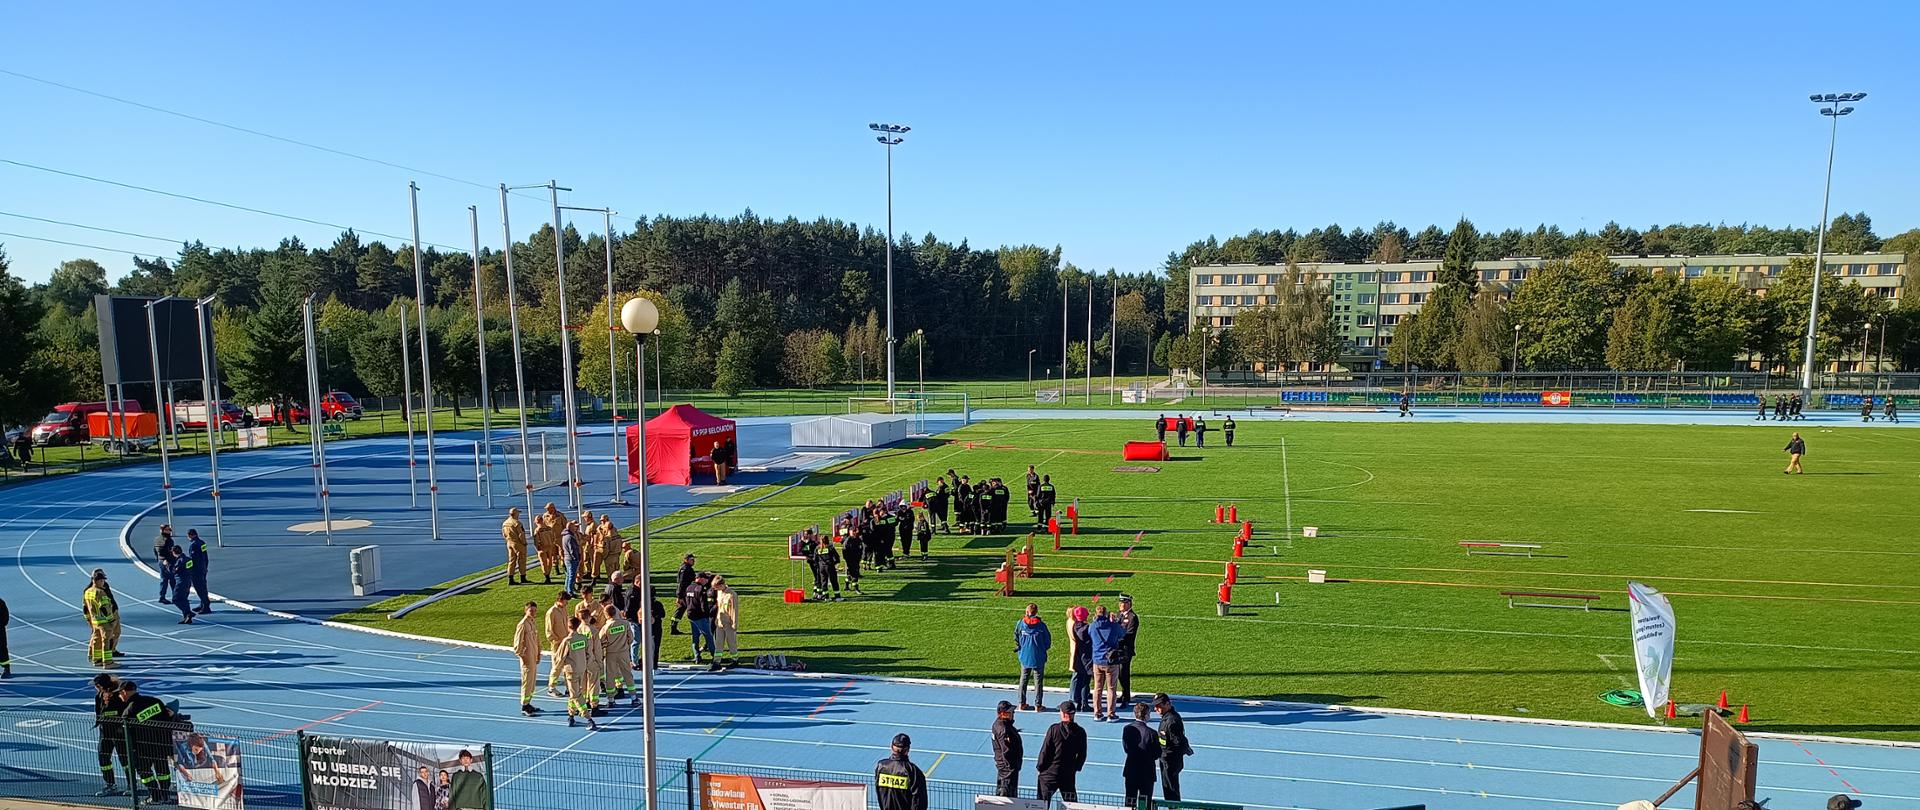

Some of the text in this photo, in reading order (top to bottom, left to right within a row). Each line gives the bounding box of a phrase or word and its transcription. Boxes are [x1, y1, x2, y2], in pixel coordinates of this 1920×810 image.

[310, 746, 347, 757] reporter
[311, 760, 402, 780] TU UBIERA SIĘ
[312, 773, 378, 790] MŁODZIEŻ
